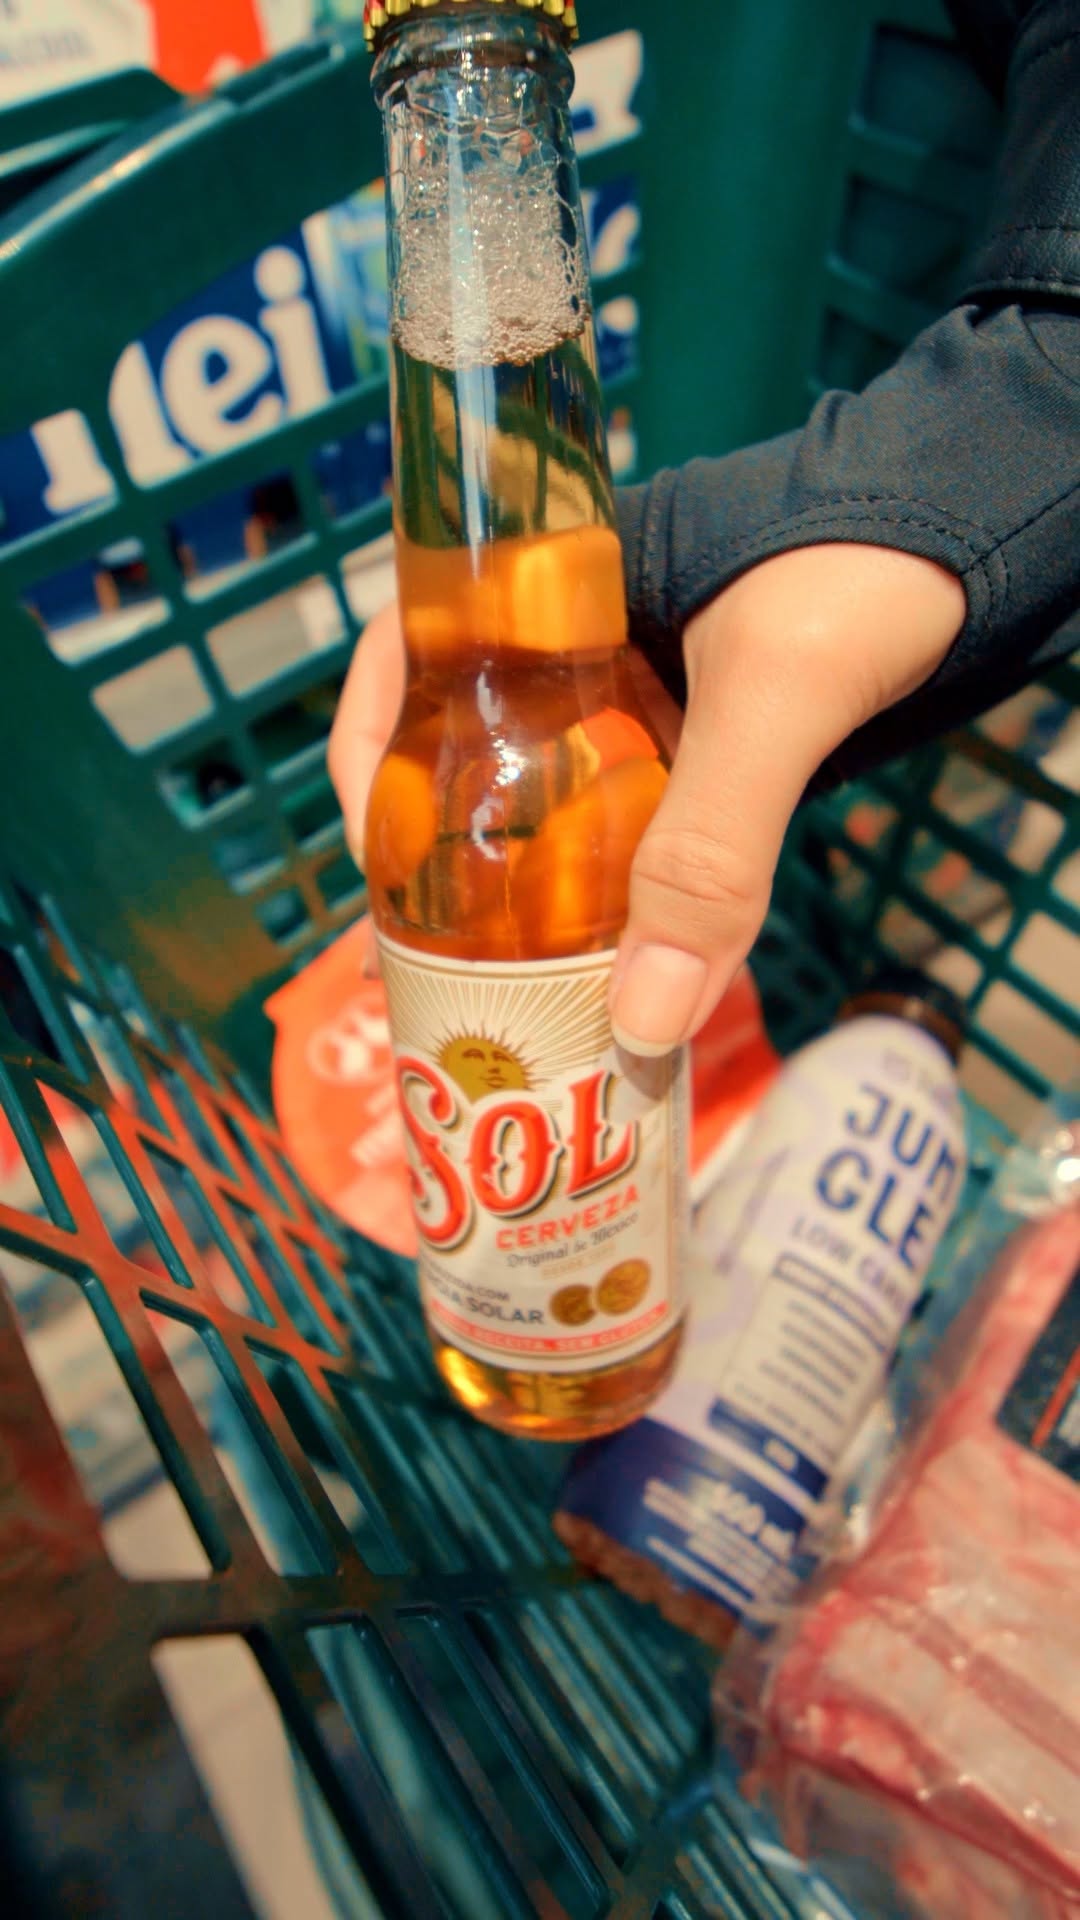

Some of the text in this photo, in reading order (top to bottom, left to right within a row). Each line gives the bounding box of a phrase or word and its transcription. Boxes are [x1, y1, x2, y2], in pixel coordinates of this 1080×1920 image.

[396, 1055, 642, 1251] SOL
[846, 1082, 957, 1202] JUN
[495, 1184, 639, 1252] CERVEZA
[816, 1147, 931, 1270] GLE
[506, 1242, 569, 1269] Original
[465, 1296, 544, 1325] SOLAR
[477, 1286, 510, 1302] COM
